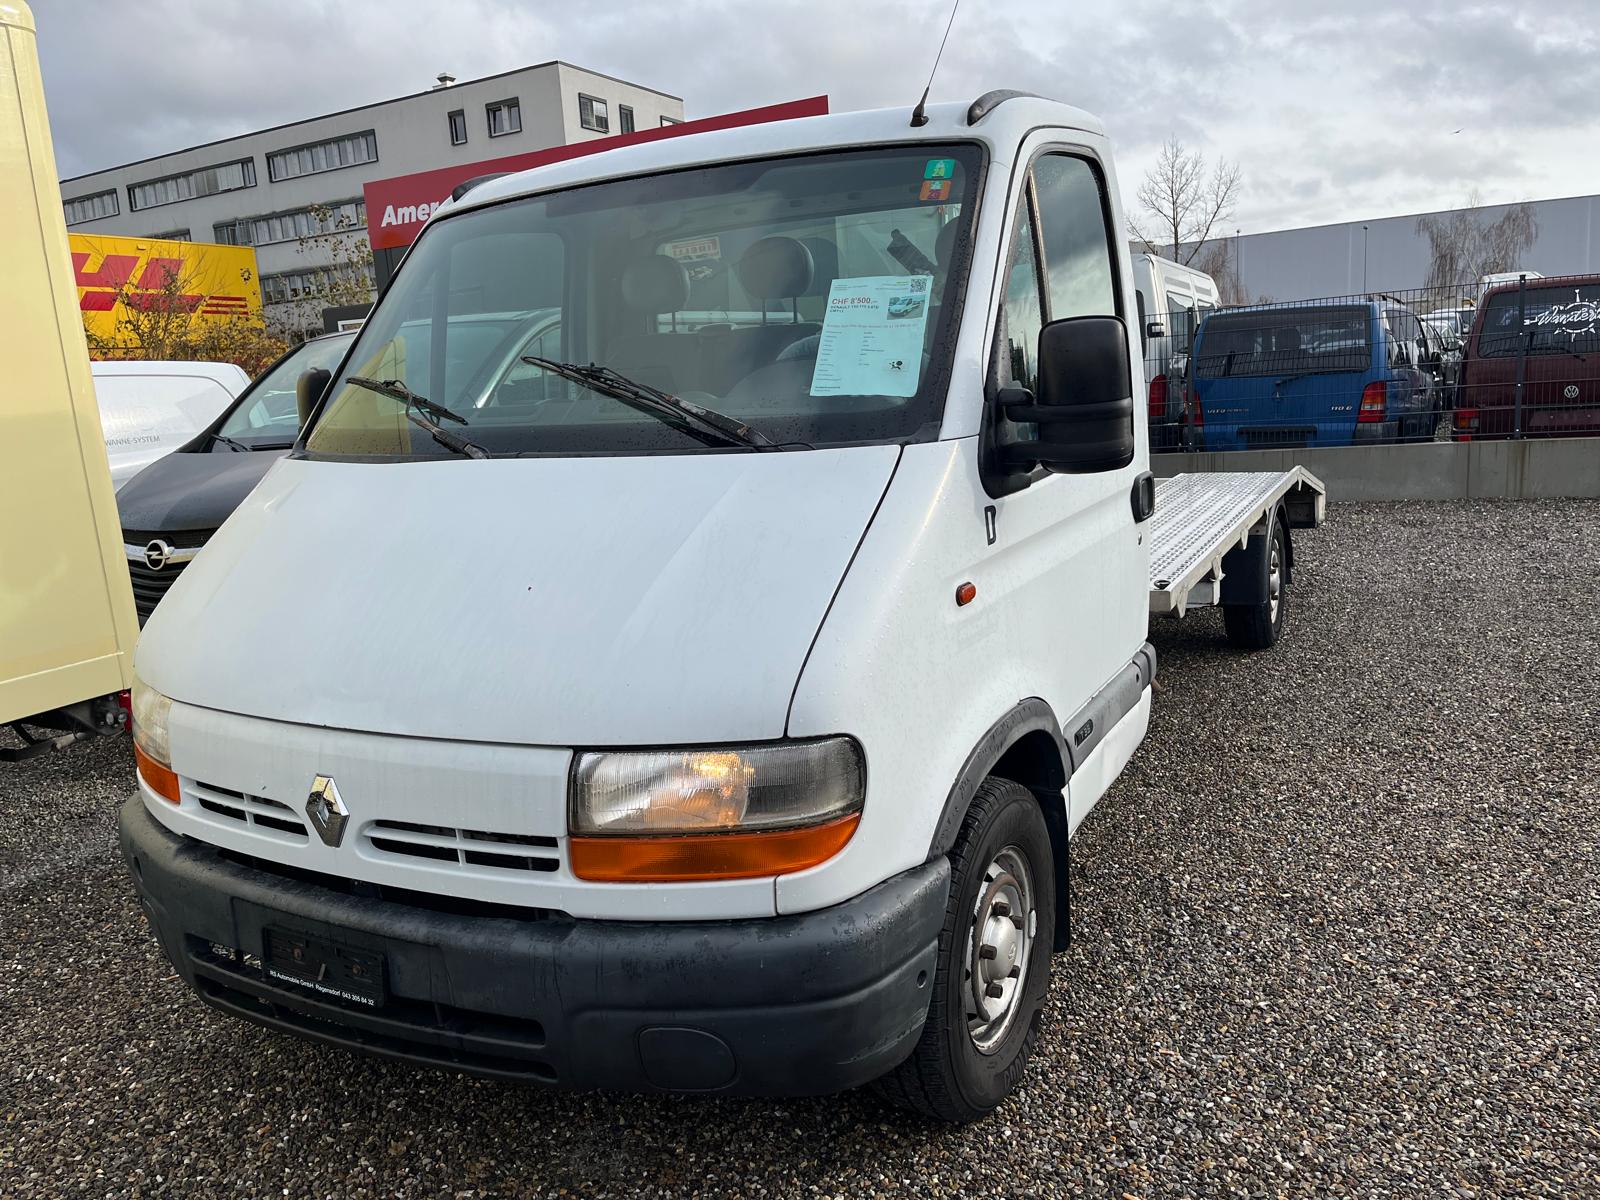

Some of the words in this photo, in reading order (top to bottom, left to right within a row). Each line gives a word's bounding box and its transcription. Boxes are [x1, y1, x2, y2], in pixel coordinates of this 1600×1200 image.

[381, 201, 440, 228] Amer
[831, 297, 848, 305] CHF
[277, 972, 300, 984] Automobile
[300, 979, 314, 989] GmbH
[315, 984, 341, 996] Regensdorf
